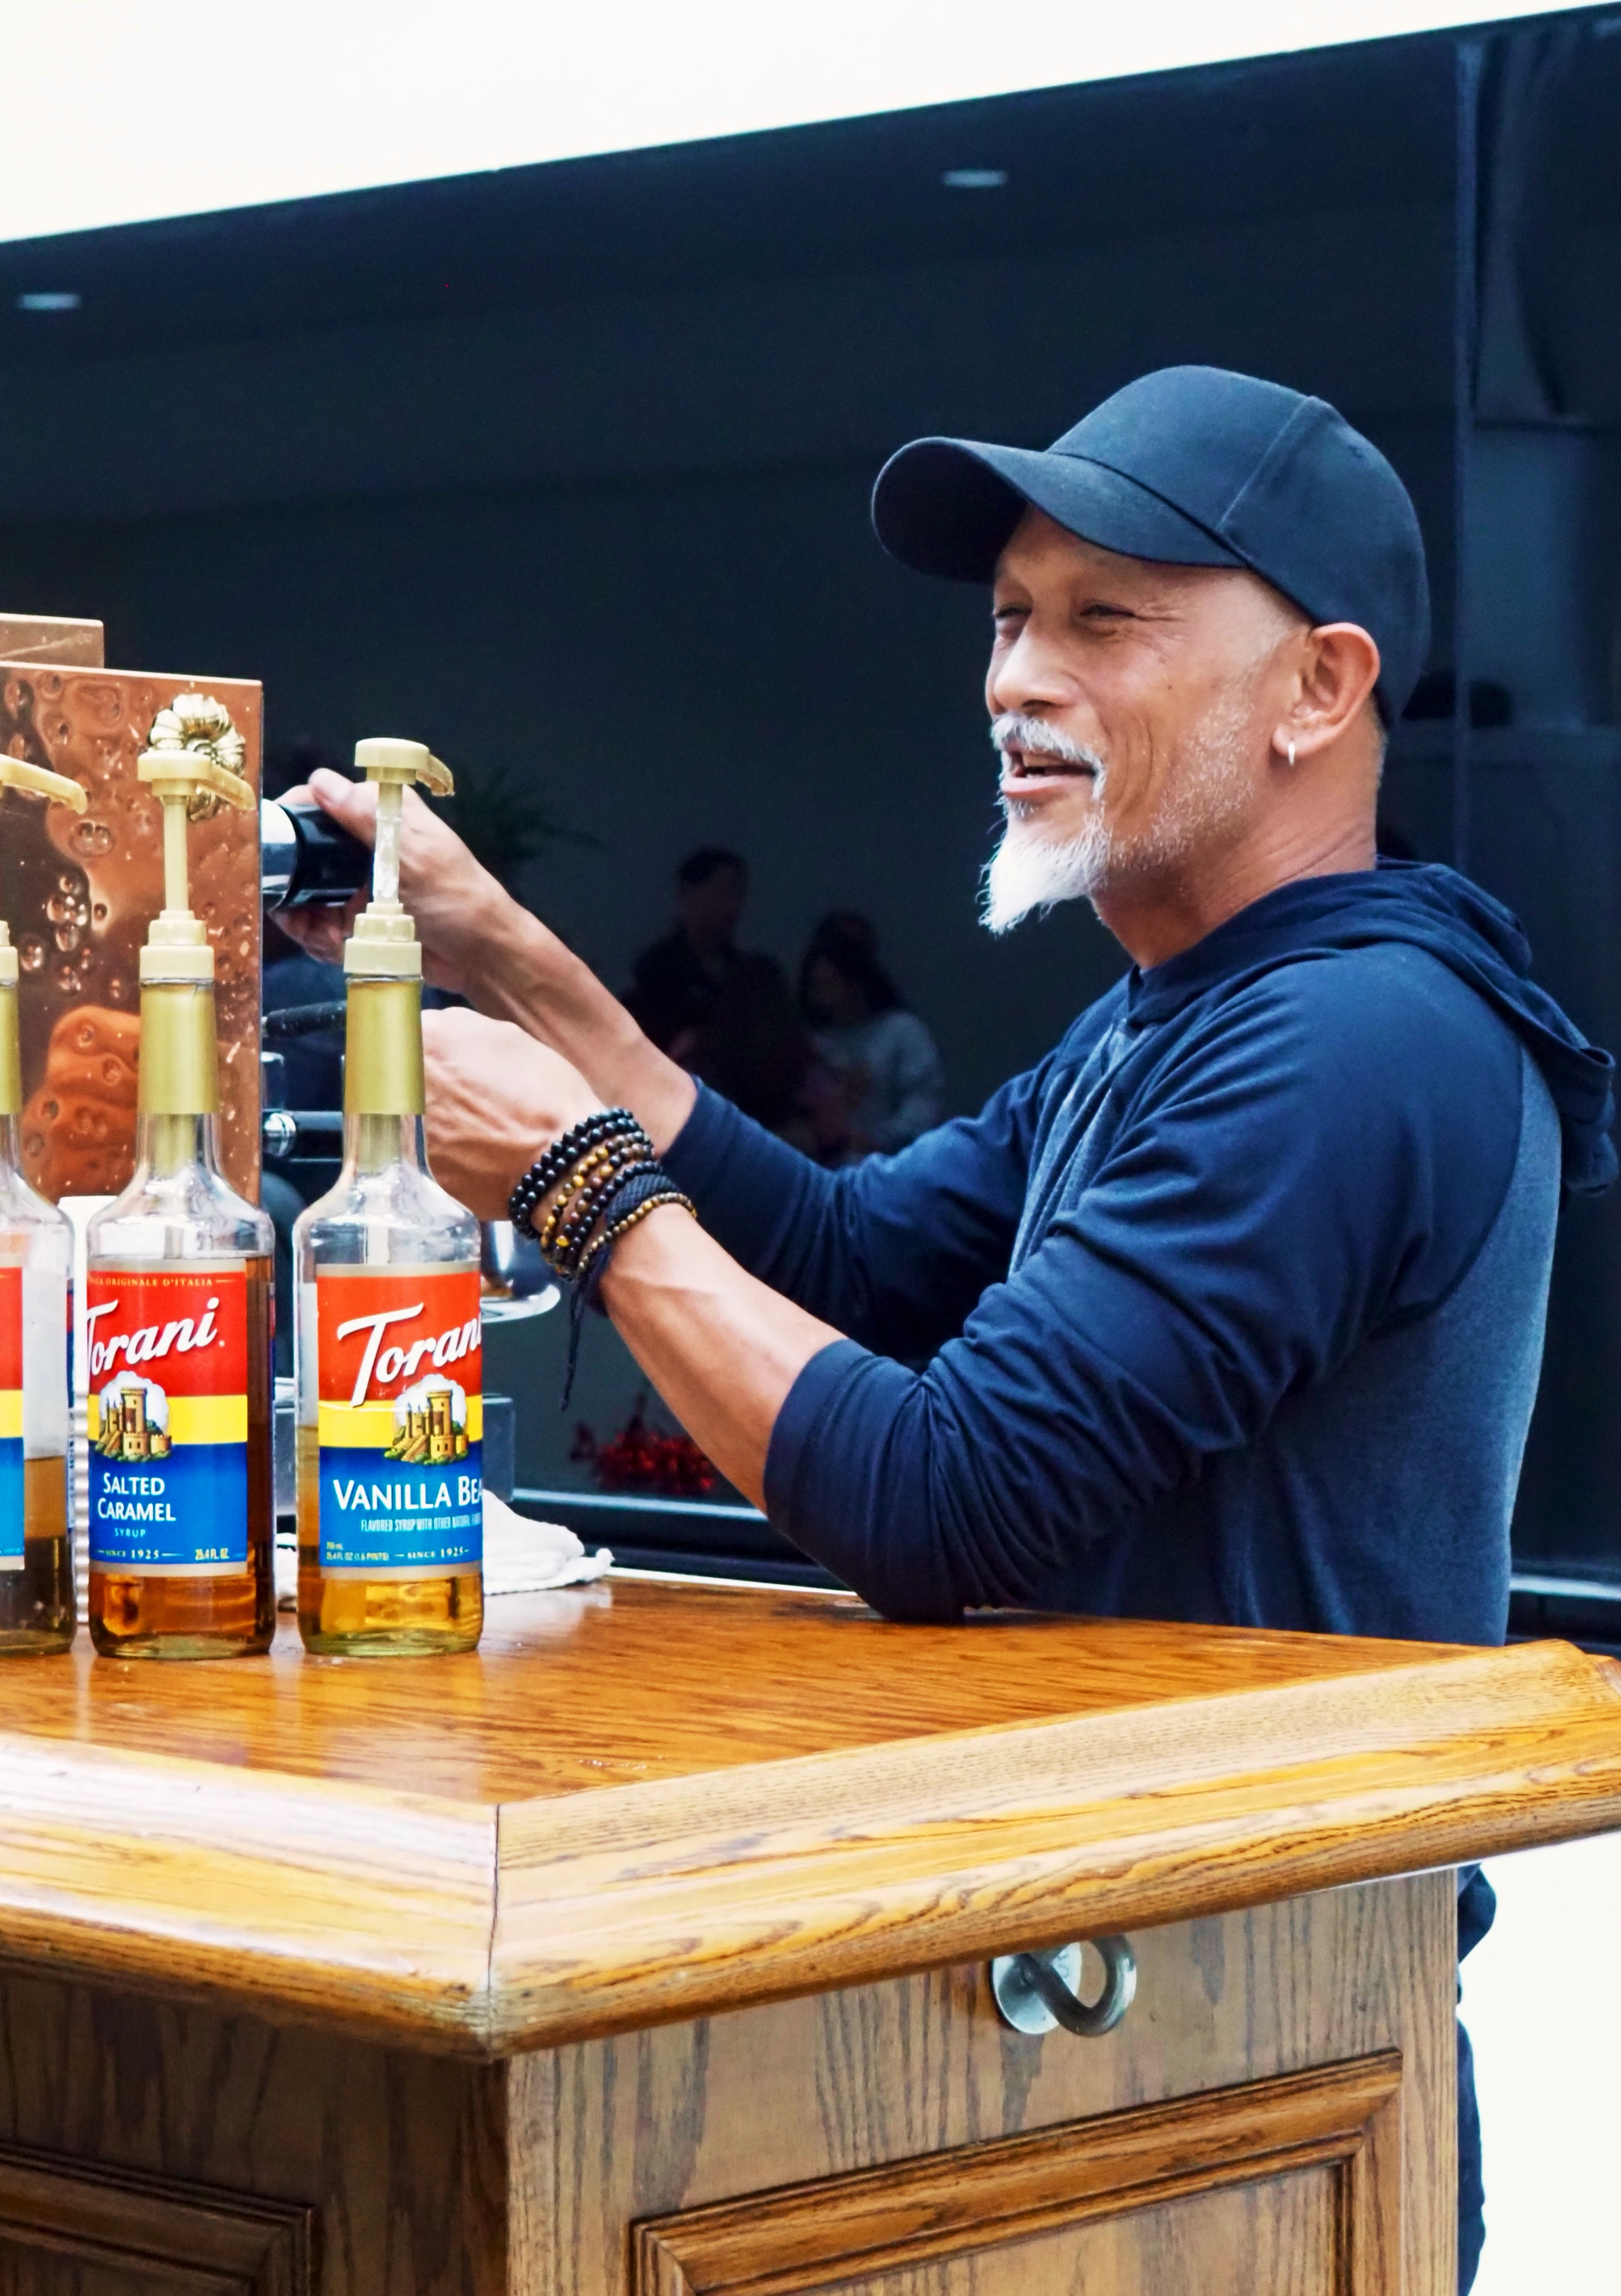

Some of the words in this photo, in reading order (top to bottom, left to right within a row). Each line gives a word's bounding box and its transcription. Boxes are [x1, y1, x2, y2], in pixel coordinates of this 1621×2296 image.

[163, 1278, 213, 1286] D'ITALIA
[103, 1472, 165, 1496] SALTED
[333, 1479, 452, 1510] VANILLA
[97, 1498, 177, 1522] CARAMEL
[114, 1527, 146, 1538] SYRUP
[131, 1549, 159, 1559] 1925
